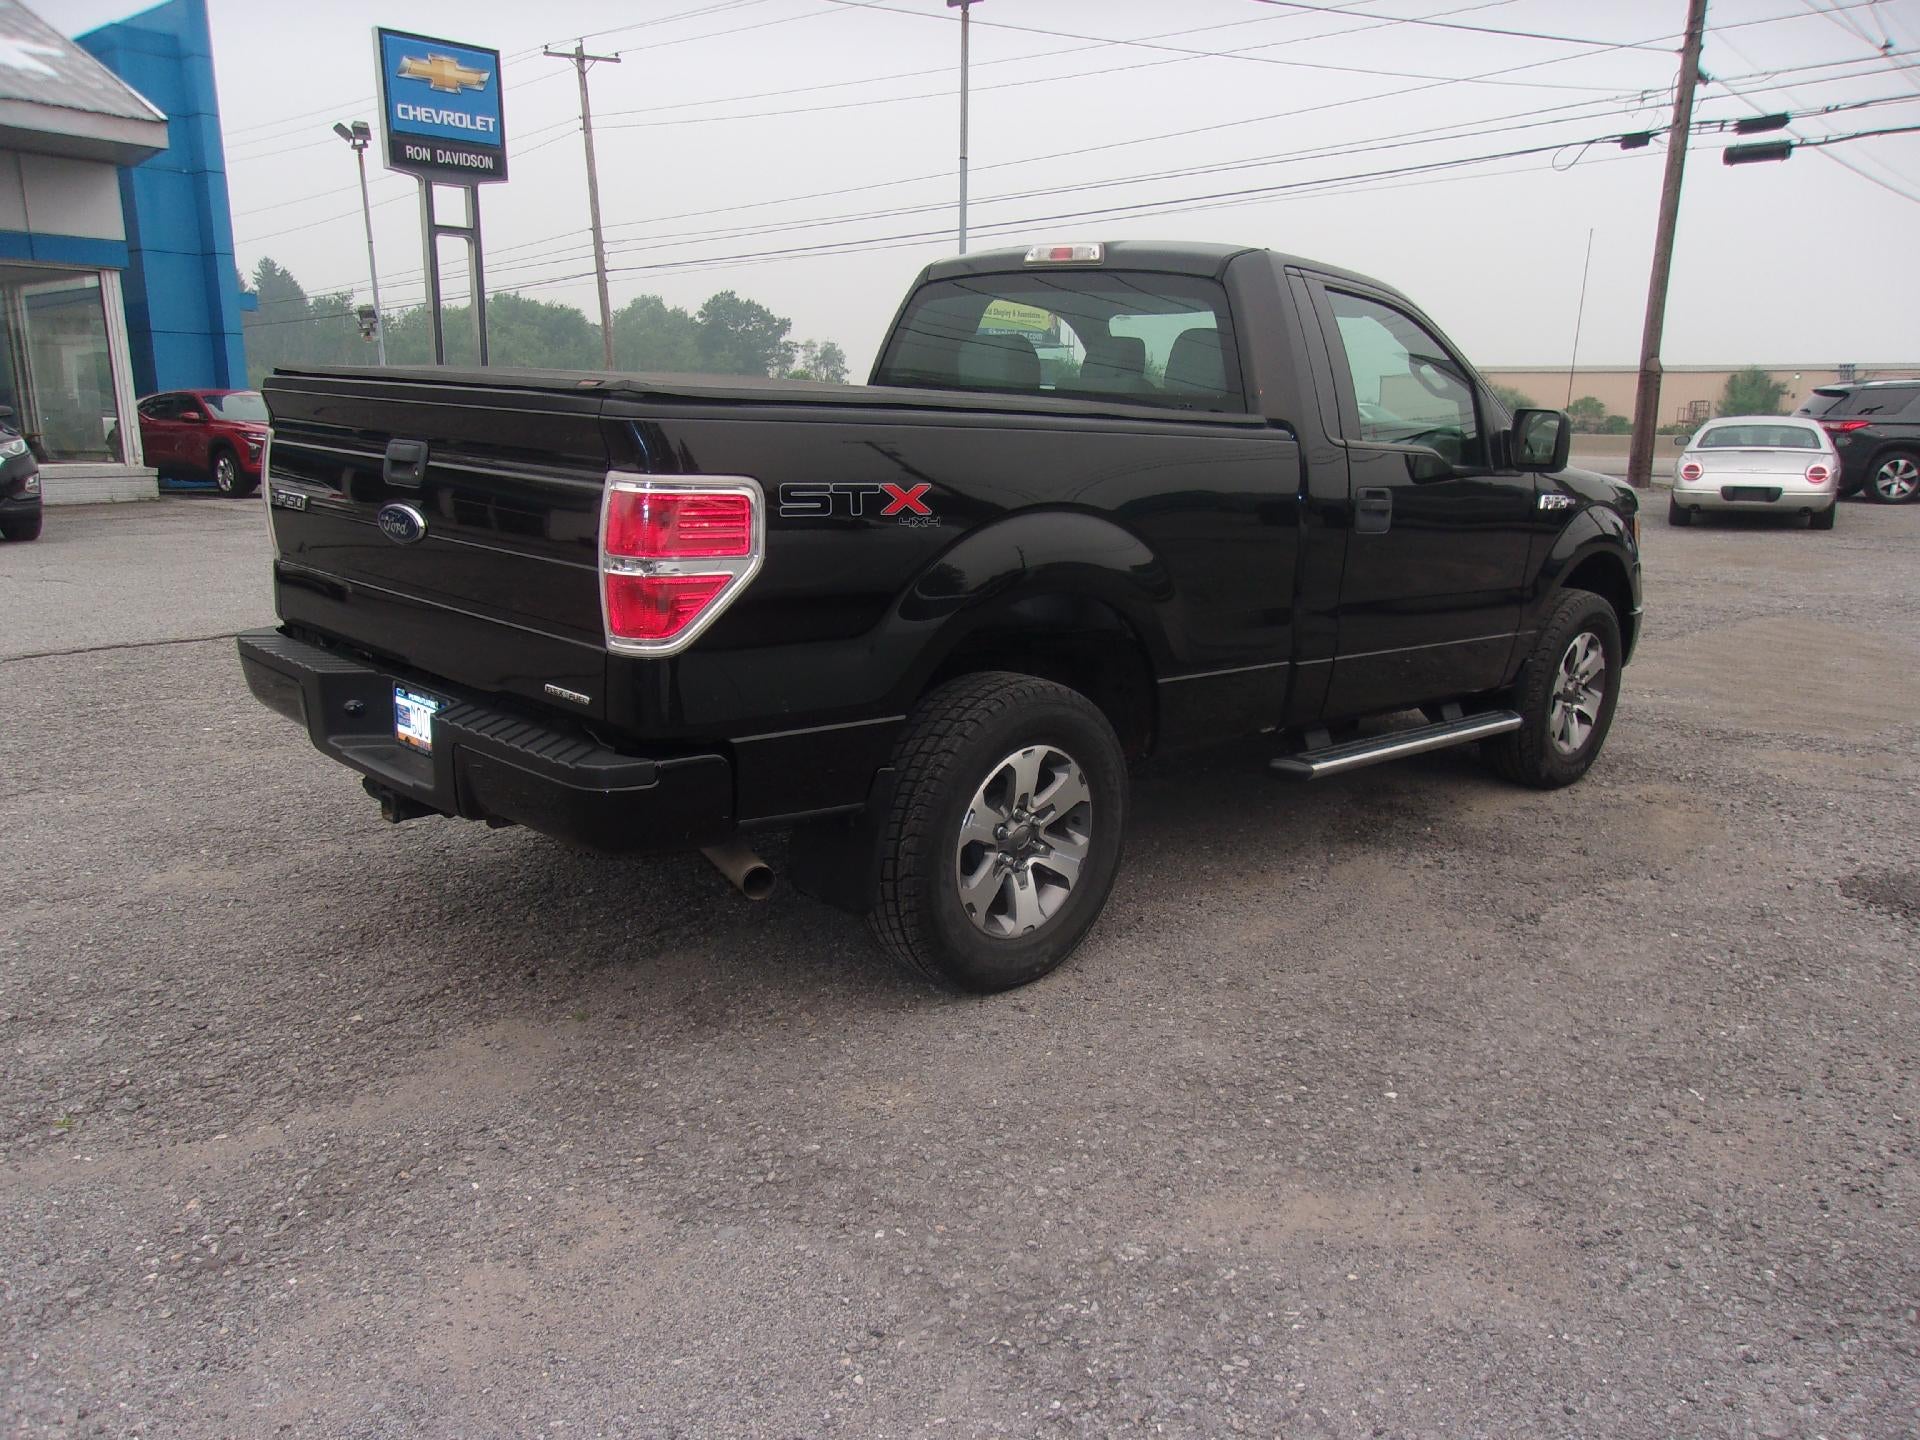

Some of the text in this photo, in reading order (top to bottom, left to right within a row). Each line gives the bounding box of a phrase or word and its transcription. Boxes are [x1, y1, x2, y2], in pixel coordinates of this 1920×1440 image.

[397, 103, 496, 132] CHEVROLET
[405, 145, 494, 170] RON DAVIDSON
[779, 483, 933, 517] STX
[380, 510, 410, 536] Ford
